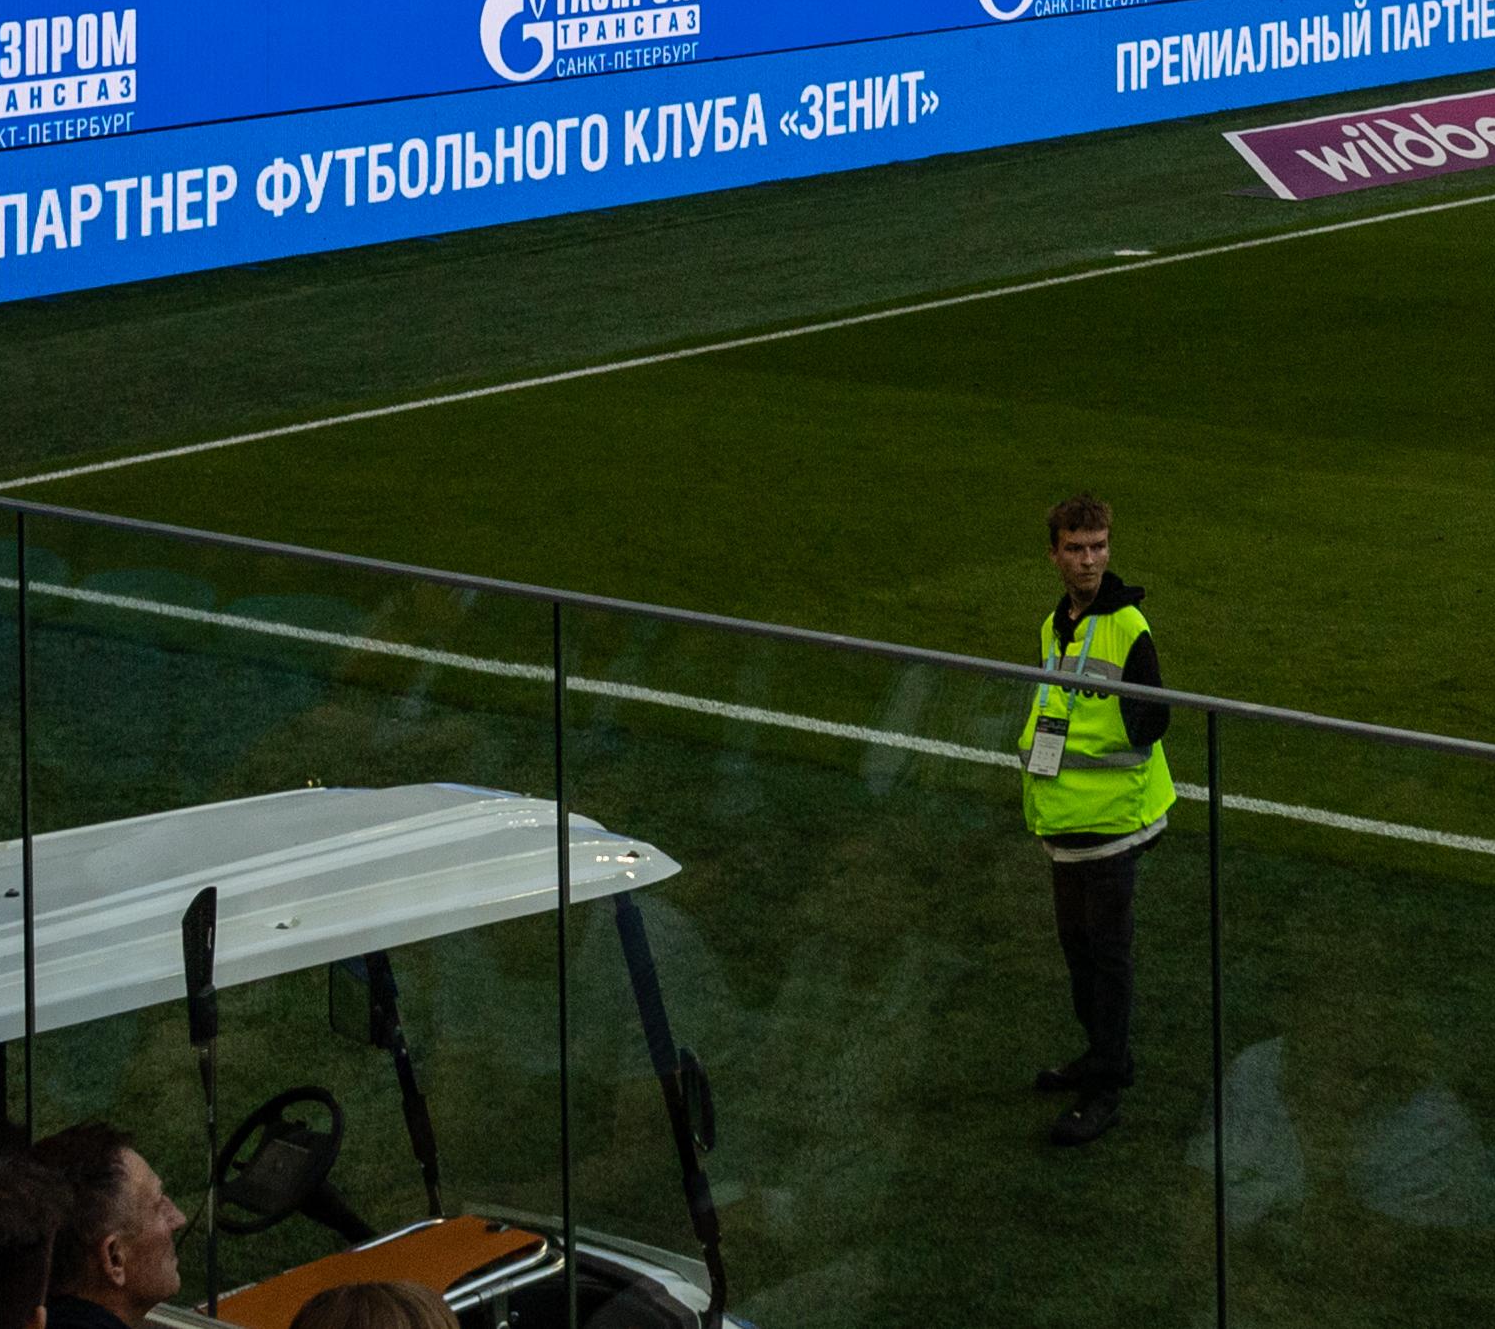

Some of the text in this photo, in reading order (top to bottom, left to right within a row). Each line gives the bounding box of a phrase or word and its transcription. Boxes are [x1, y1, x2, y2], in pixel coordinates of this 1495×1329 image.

[560, 3, 699, 46] ТРАНСГАЗ
[555, 39, 701, 80] САНКТ-ПЕТЕРБУРГ
[257, 108, 610, 216] ФУТБОЛЬНОГО
[624, 93, 770, 174] КЛУБА
[779, 68, 942, 143] «ЗЕНИТ»
